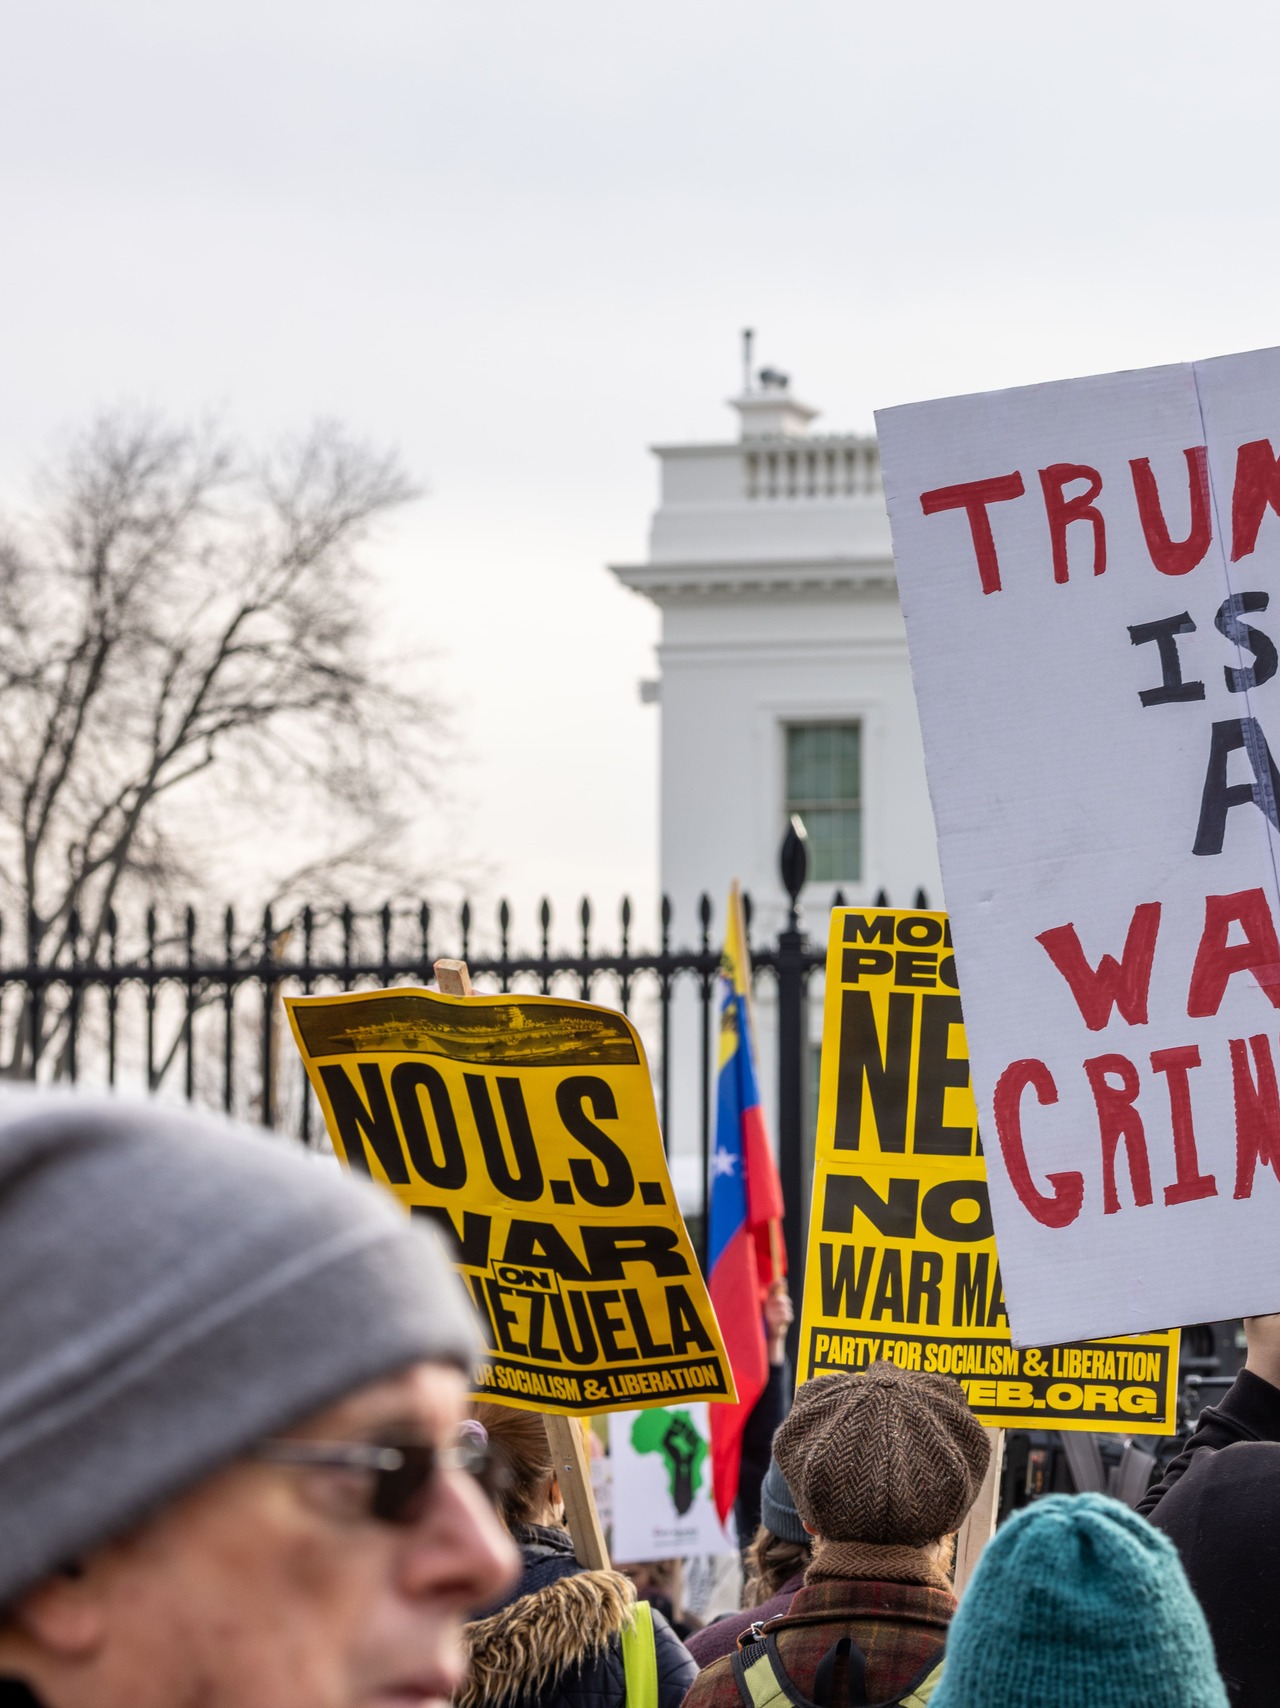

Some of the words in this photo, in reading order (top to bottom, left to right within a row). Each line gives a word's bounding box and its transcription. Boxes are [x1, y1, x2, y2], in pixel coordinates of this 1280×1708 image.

[1127, 591, 1279, 707] IS
[842, 914, 954, 948] MO
[834, 989, 985, 1156] NE
[318, 1061, 467, 1190] NO
[463, 1075, 667, 1207] U.S.
[461, 1271, 716, 1366] NEZUELA
[498, 1267, 551, 1289] ON
[819, 1242, 943, 1326] WAR
[473, 1364, 497, 1387] OR
[497, 1364, 582, 1402] SOCIALISM
[583, 1378, 610, 1401] &
[608, 1364, 719, 1397] LIBERATION
[814, 1334, 881, 1367] PARTY
[882, 1339, 922, 1371] FOR
[924, 1343, 1019, 1377] SOCIALISM
[1022, 1349, 1049, 1377] &
[1052, 1348, 1161, 1382] LIBERATION
